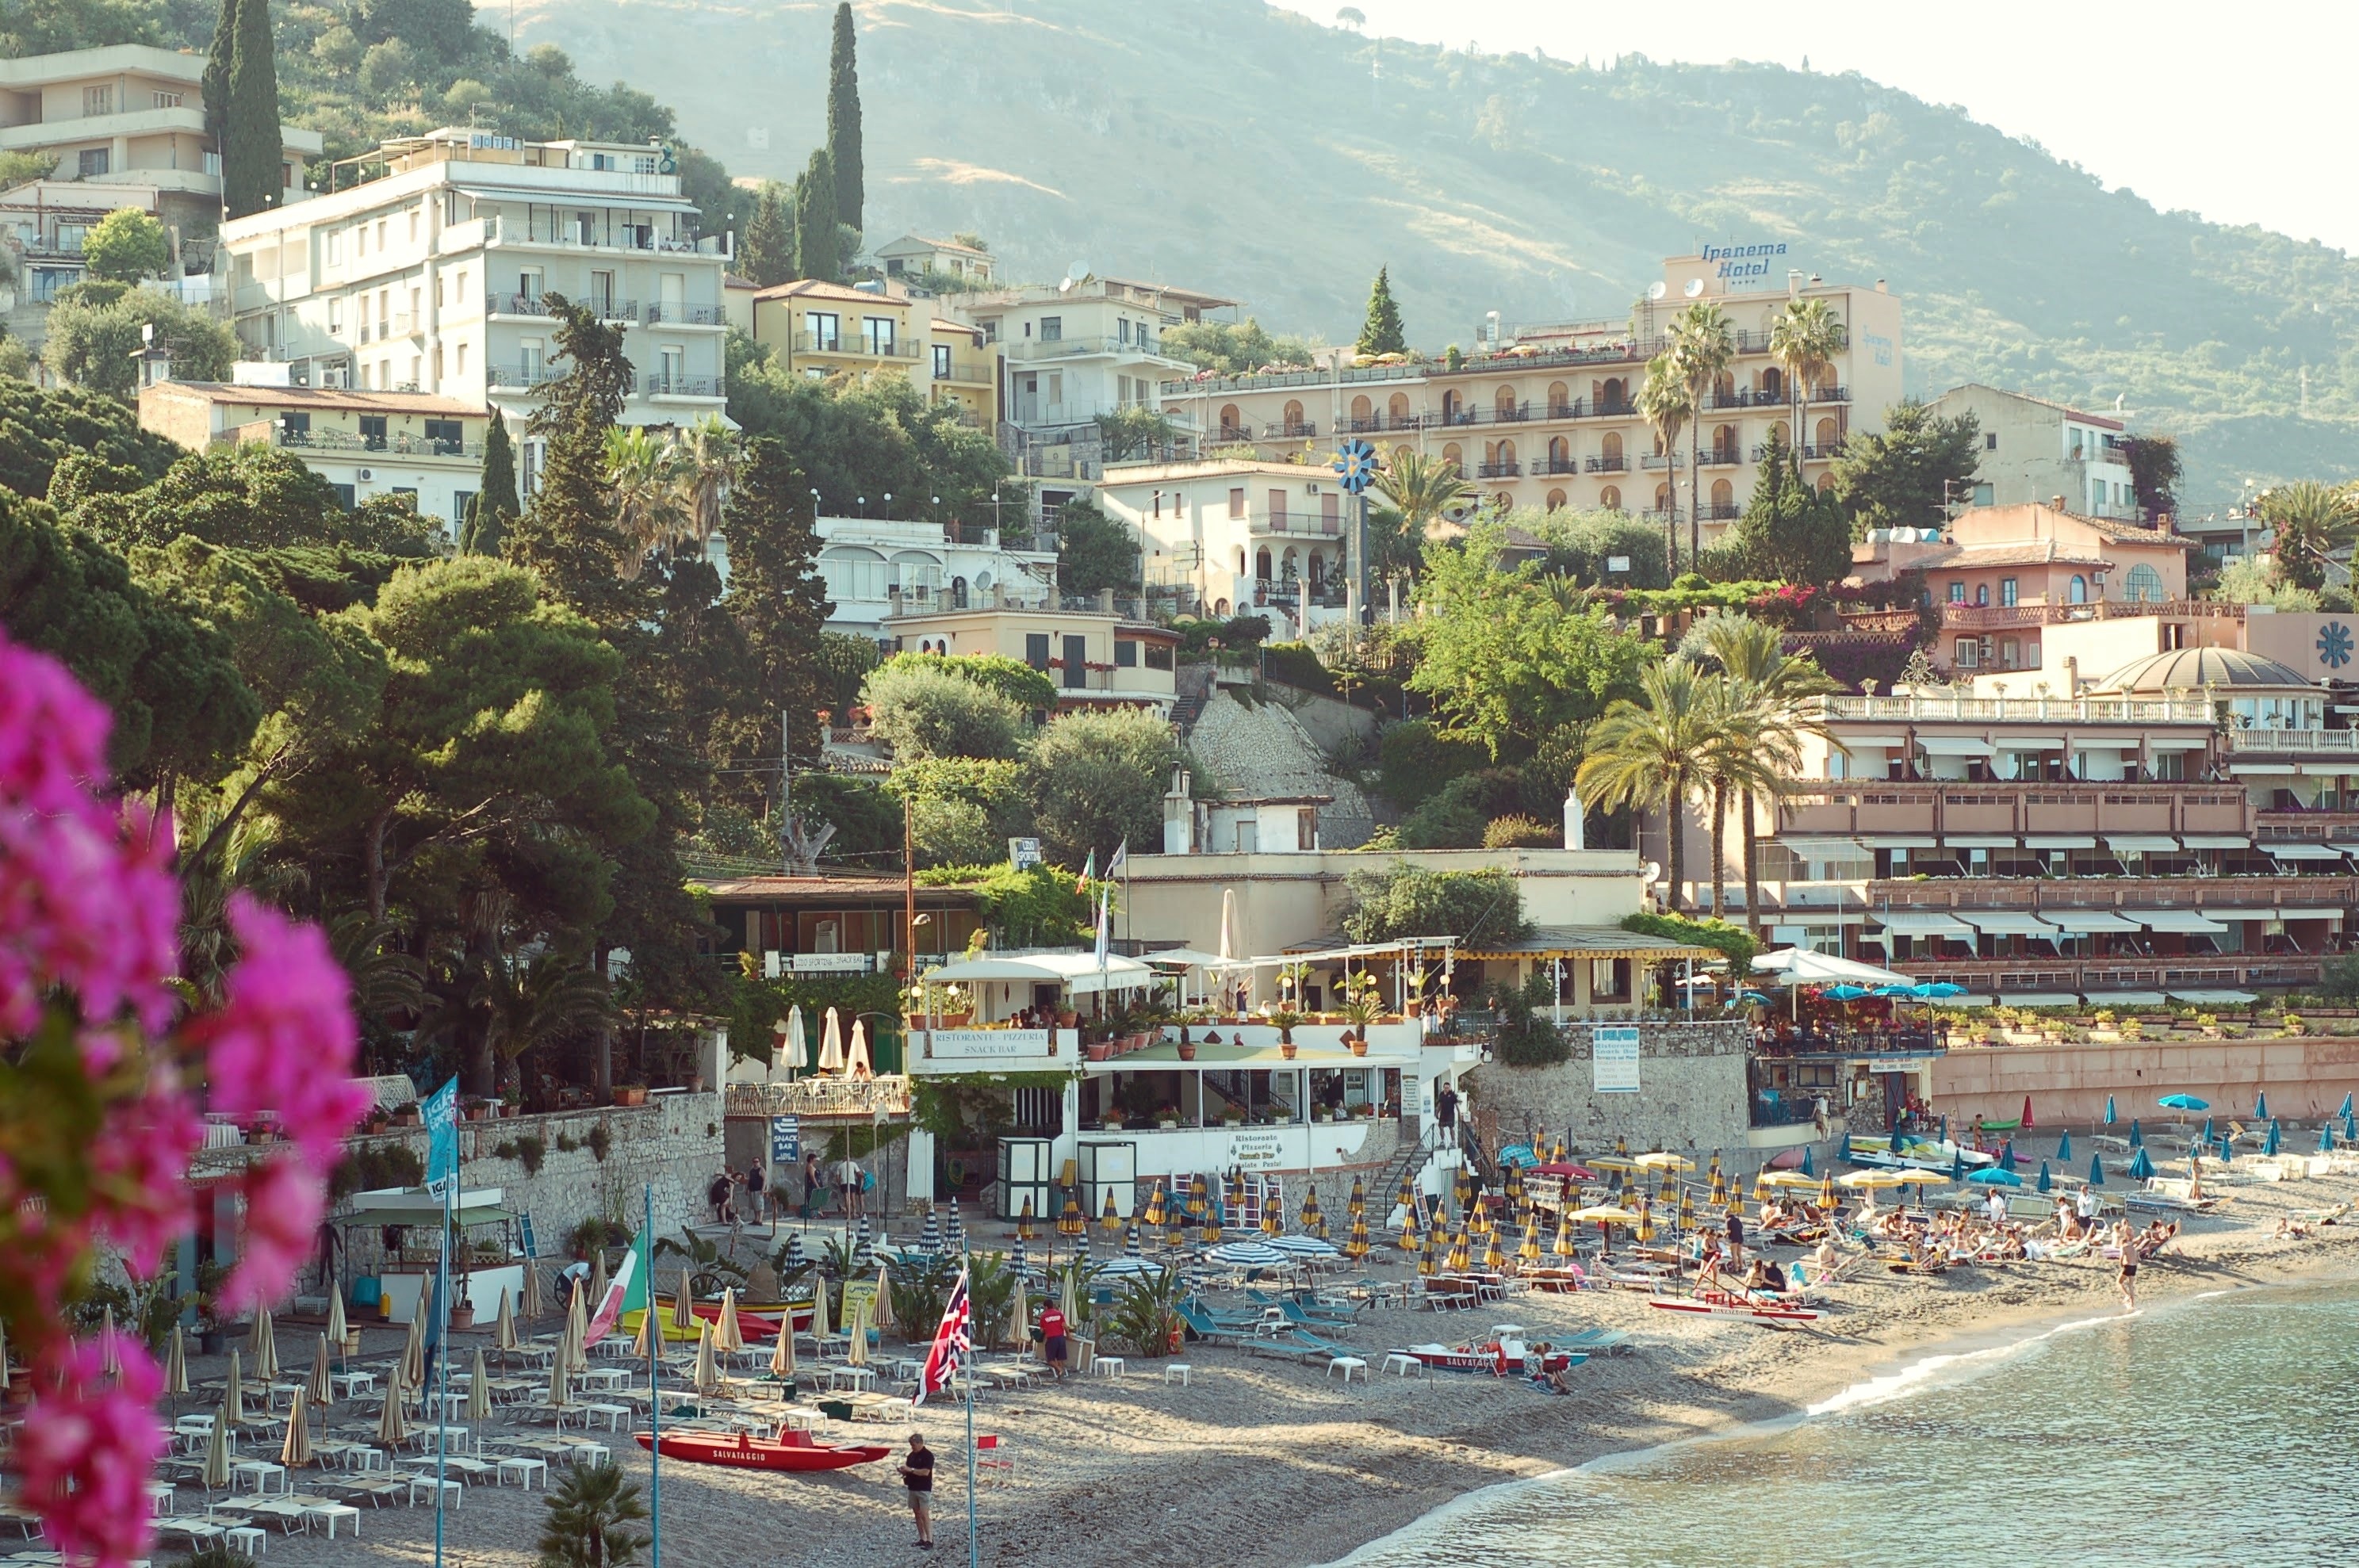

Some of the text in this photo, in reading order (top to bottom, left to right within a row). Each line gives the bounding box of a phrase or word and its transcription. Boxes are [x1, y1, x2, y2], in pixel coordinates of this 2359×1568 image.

[1702, 243, 1786, 263] Ipanema
[1718, 259, 1769, 278] Hotel
[936, 1034, 993, 1042] RISTORANTE
[713, 1450, 765, 1461] SALVATAGGIO
